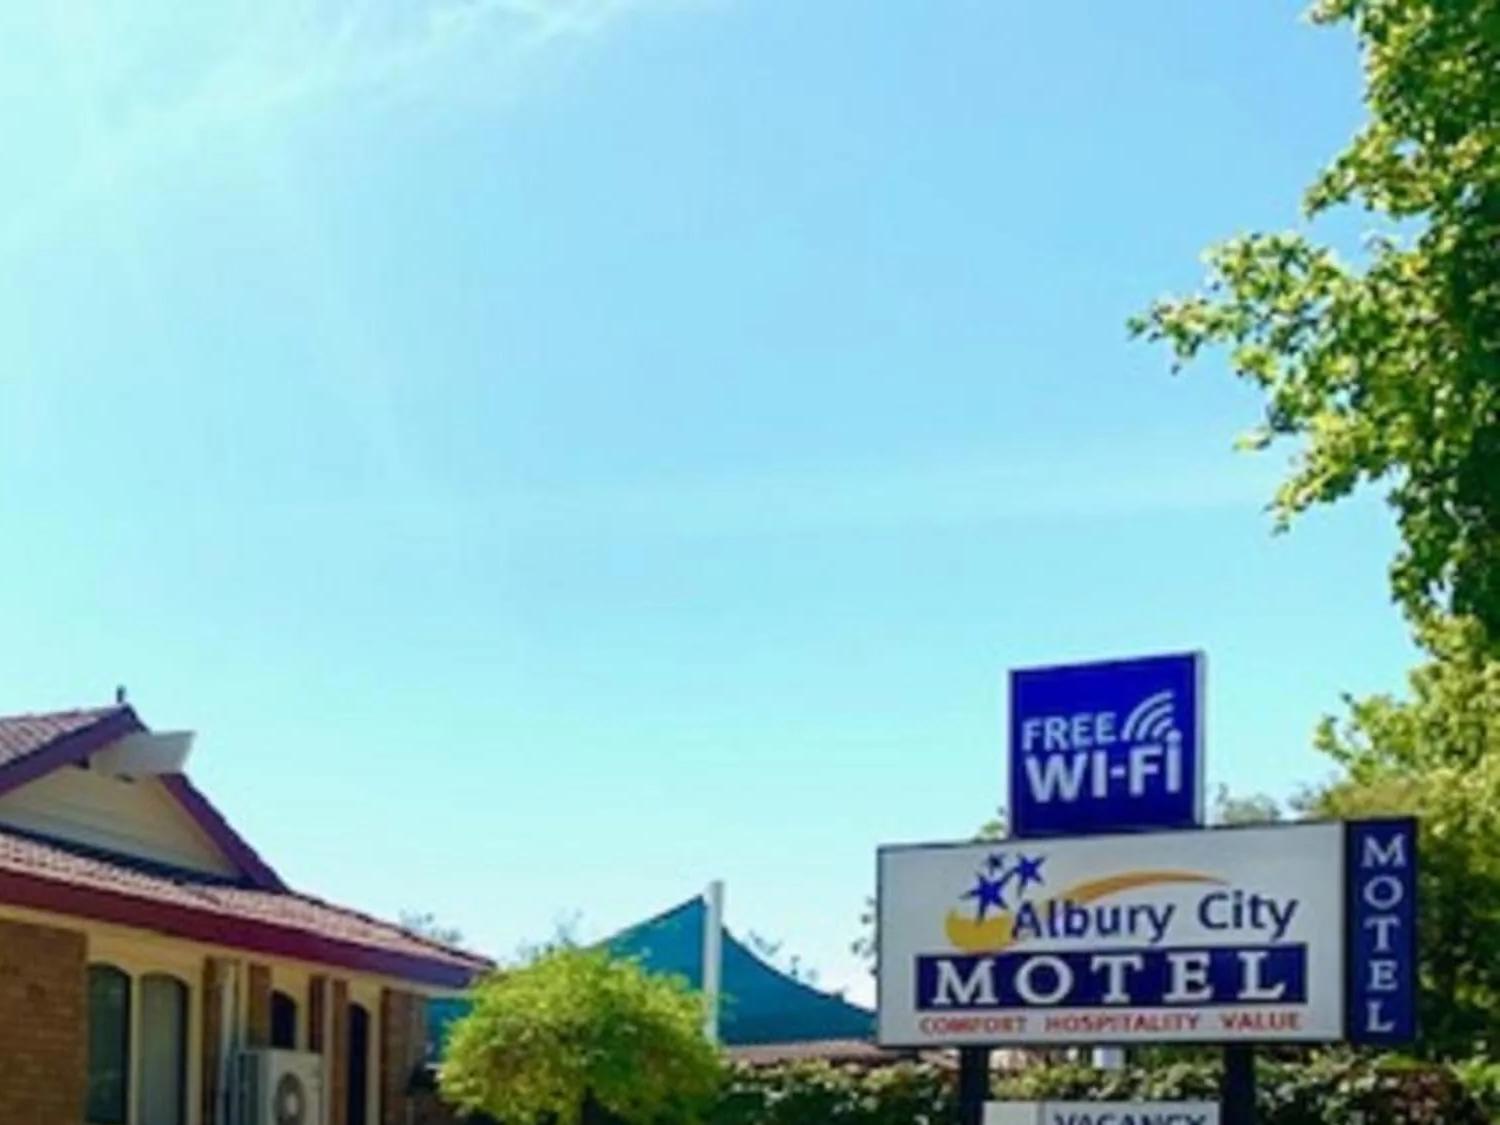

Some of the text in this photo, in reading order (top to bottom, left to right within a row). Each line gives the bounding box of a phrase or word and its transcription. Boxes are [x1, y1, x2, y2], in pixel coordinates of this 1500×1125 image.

[1021, 711, 1117, 751] FREE
[1011, 889, 1299, 943] Albury City
[1361, 832, 1406, 1034] MOTEL
[931, 950, 1287, 1006] MOTEL
[920, 1010, 1301, 1036] COMFORT HOSPITALITY VALUE
